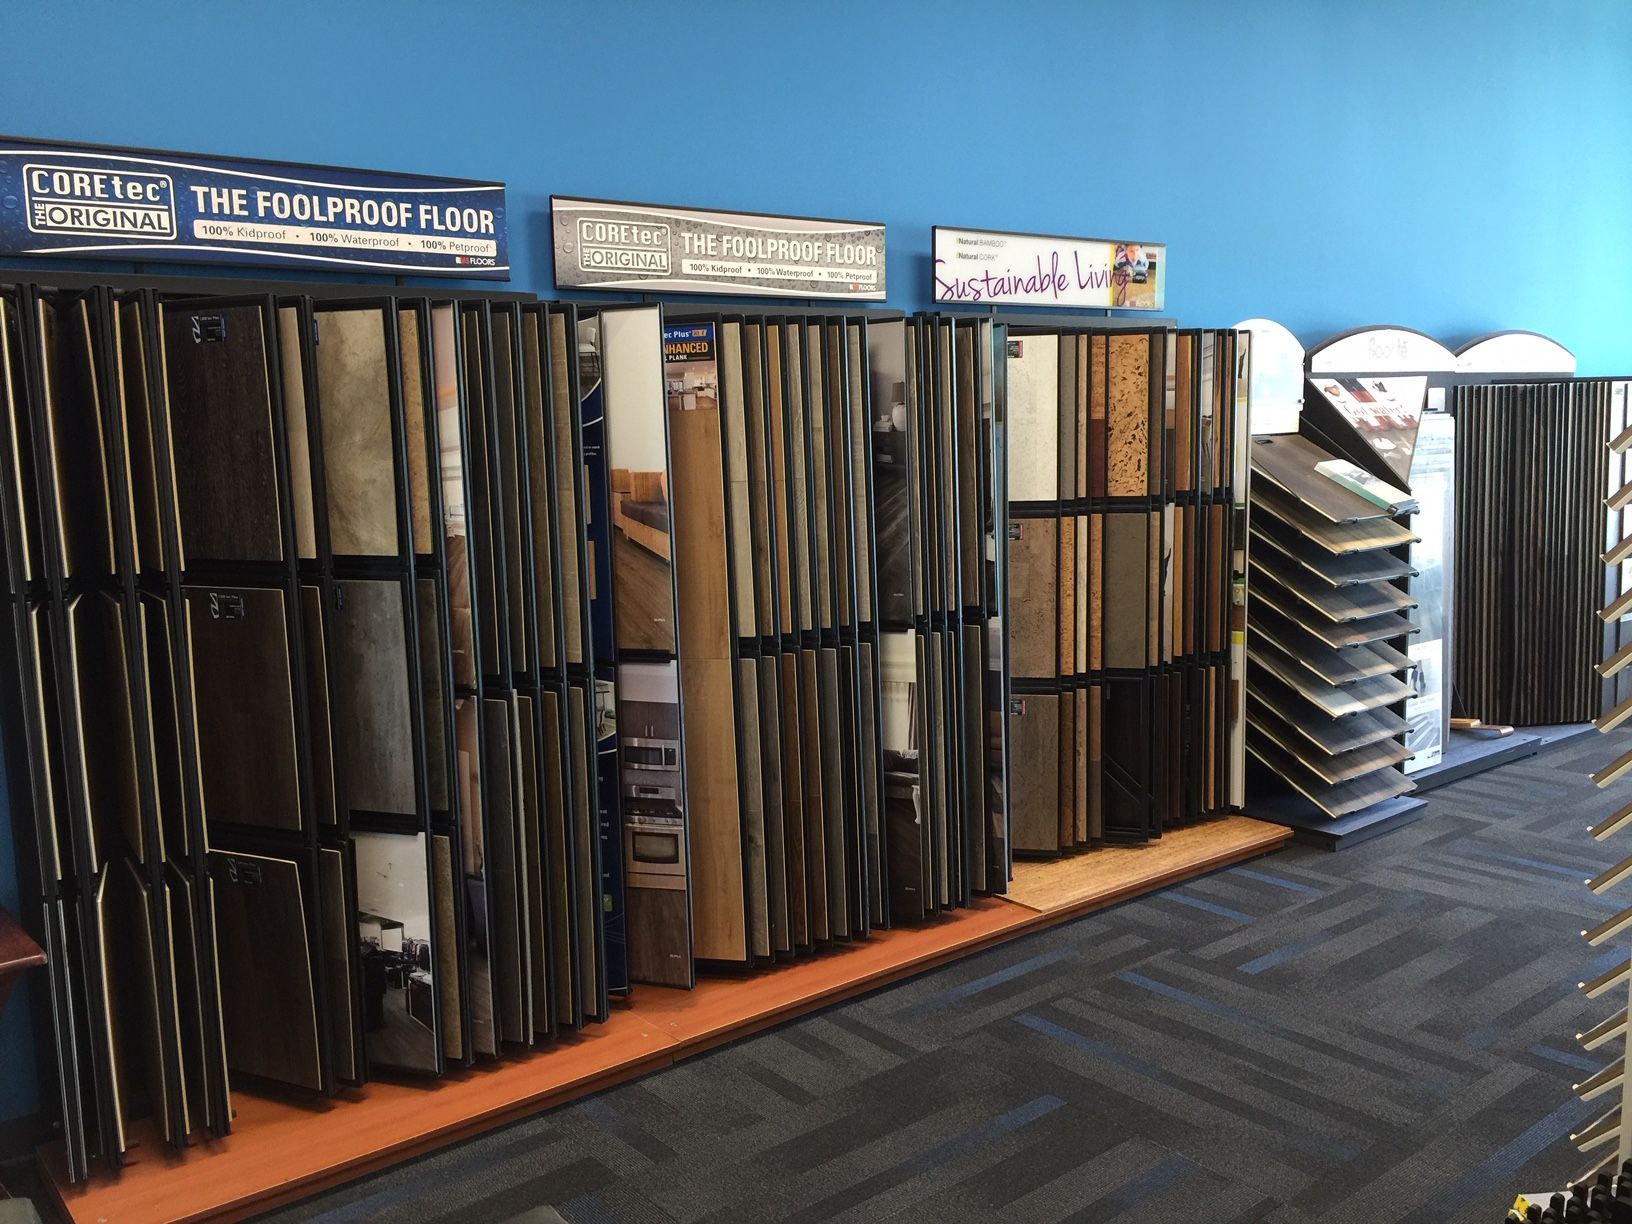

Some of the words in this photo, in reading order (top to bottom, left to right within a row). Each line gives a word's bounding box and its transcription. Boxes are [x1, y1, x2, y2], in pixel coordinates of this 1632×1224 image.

[33, 202, 46, 226] THE
[48, 206, 168, 231] ORIGINAL
[190, 185, 249, 216] THE
[256, 190, 413, 228] FOOLPROOF
[419, 204, 495, 234] FLOOR
[202, 225, 234, 237] 100%
[236, 227, 287, 240] Kidproof
[309, 232, 339, 243] 100%
[340, 234, 400, 249] Waterproof
[420, 239, 447, 251] 100%
[449, 241, 490, 254] Petproof
[681, 232, 718, 256] THE
[722, 235, 823, 262] FOOLPROOF
[826, 243, 877, 265] FLOOR
[958, 237, 978, 246] Natural
[583, 247, 591, 266] THE
[591, 250, 666, 268] ORIGINAL
[958, 252, 978, 260] Natural
[690, 263, 710, 272] 100%
[711, 264, 742, 276] Kidproof
[757, 267, 776, 276] 100%
[776, 267, 814, 279] Waterproof
[827, 271, 844, 280] 100%
[845, 272, 872, 282] Petproof
[936, 251, 1070, 301] Sustainable
[1074, 250, 1131, 307] Living
[664, 342, 708, 354] NHANCED
